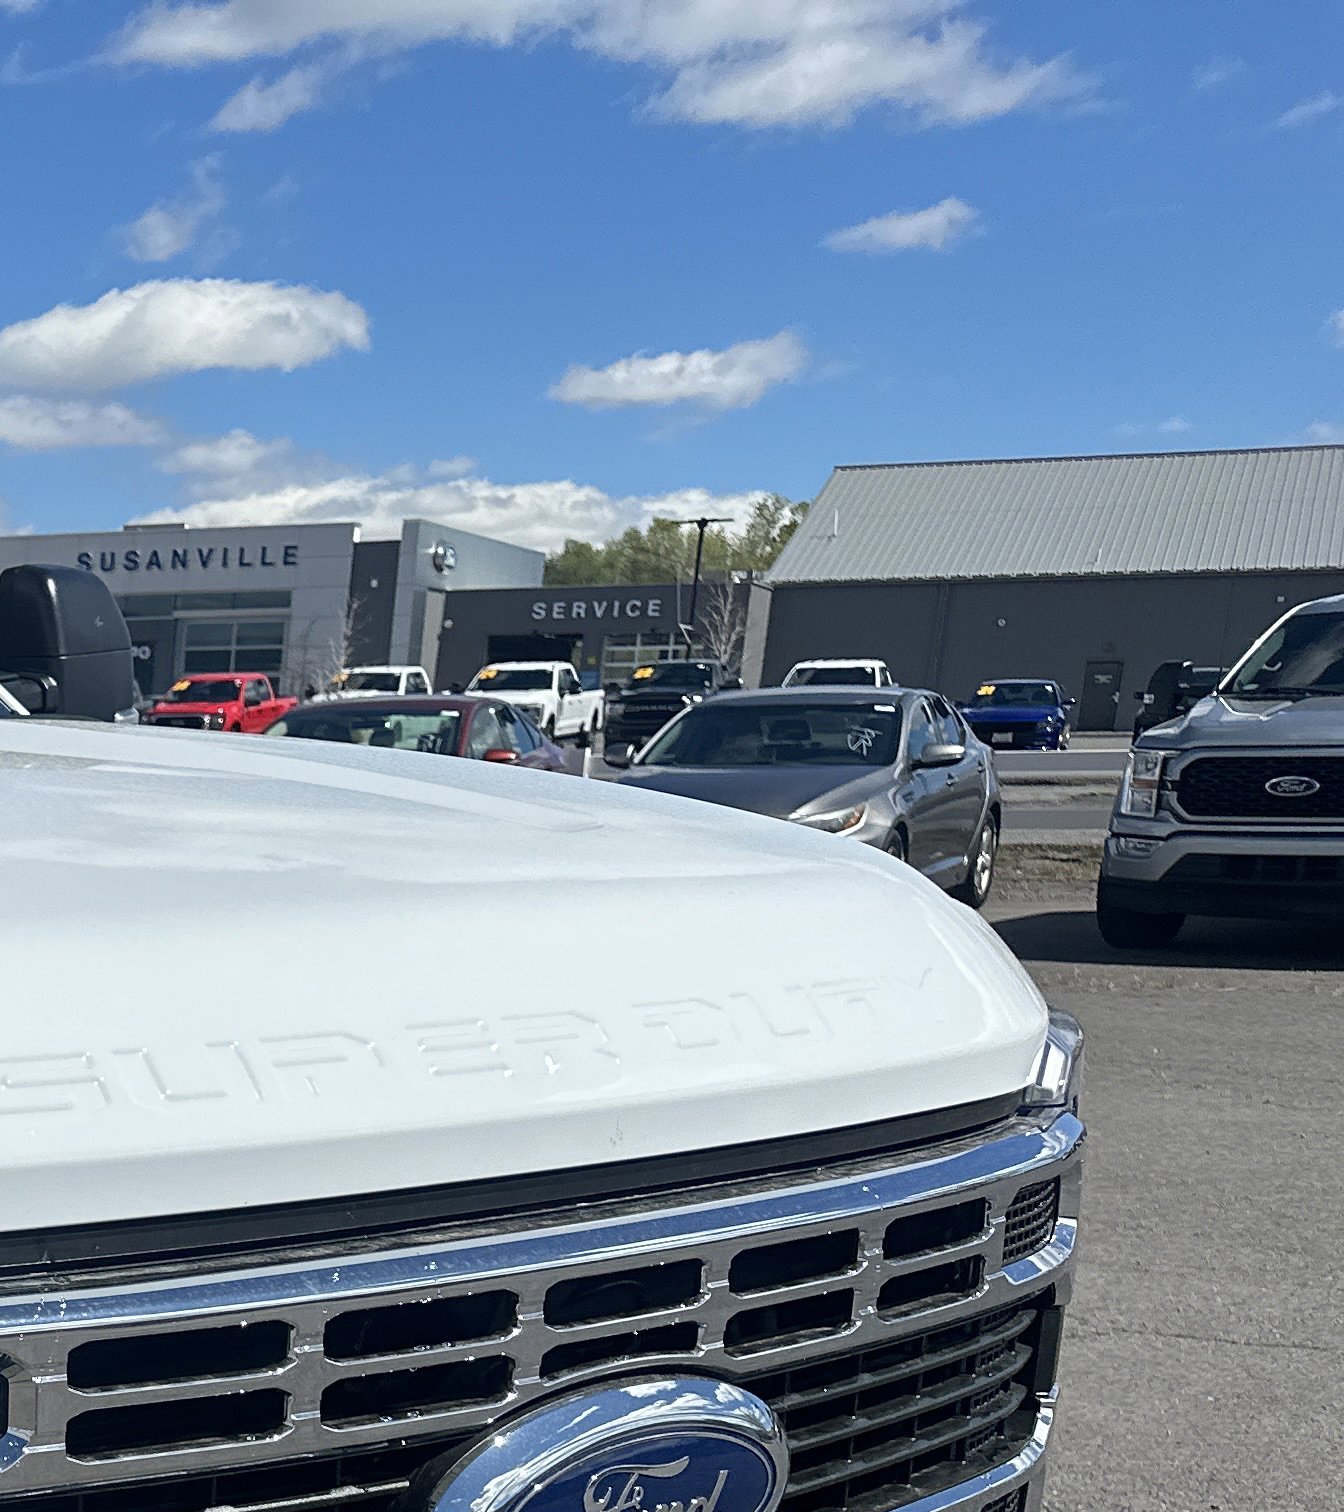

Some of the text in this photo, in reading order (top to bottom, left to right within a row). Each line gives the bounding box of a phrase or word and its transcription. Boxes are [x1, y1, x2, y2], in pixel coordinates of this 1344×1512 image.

[77, 545, 299, 572] SUSANVILLE
[531, 599, 662, 620] SERVICE
[1276, 780, 1307, 792] Ford
